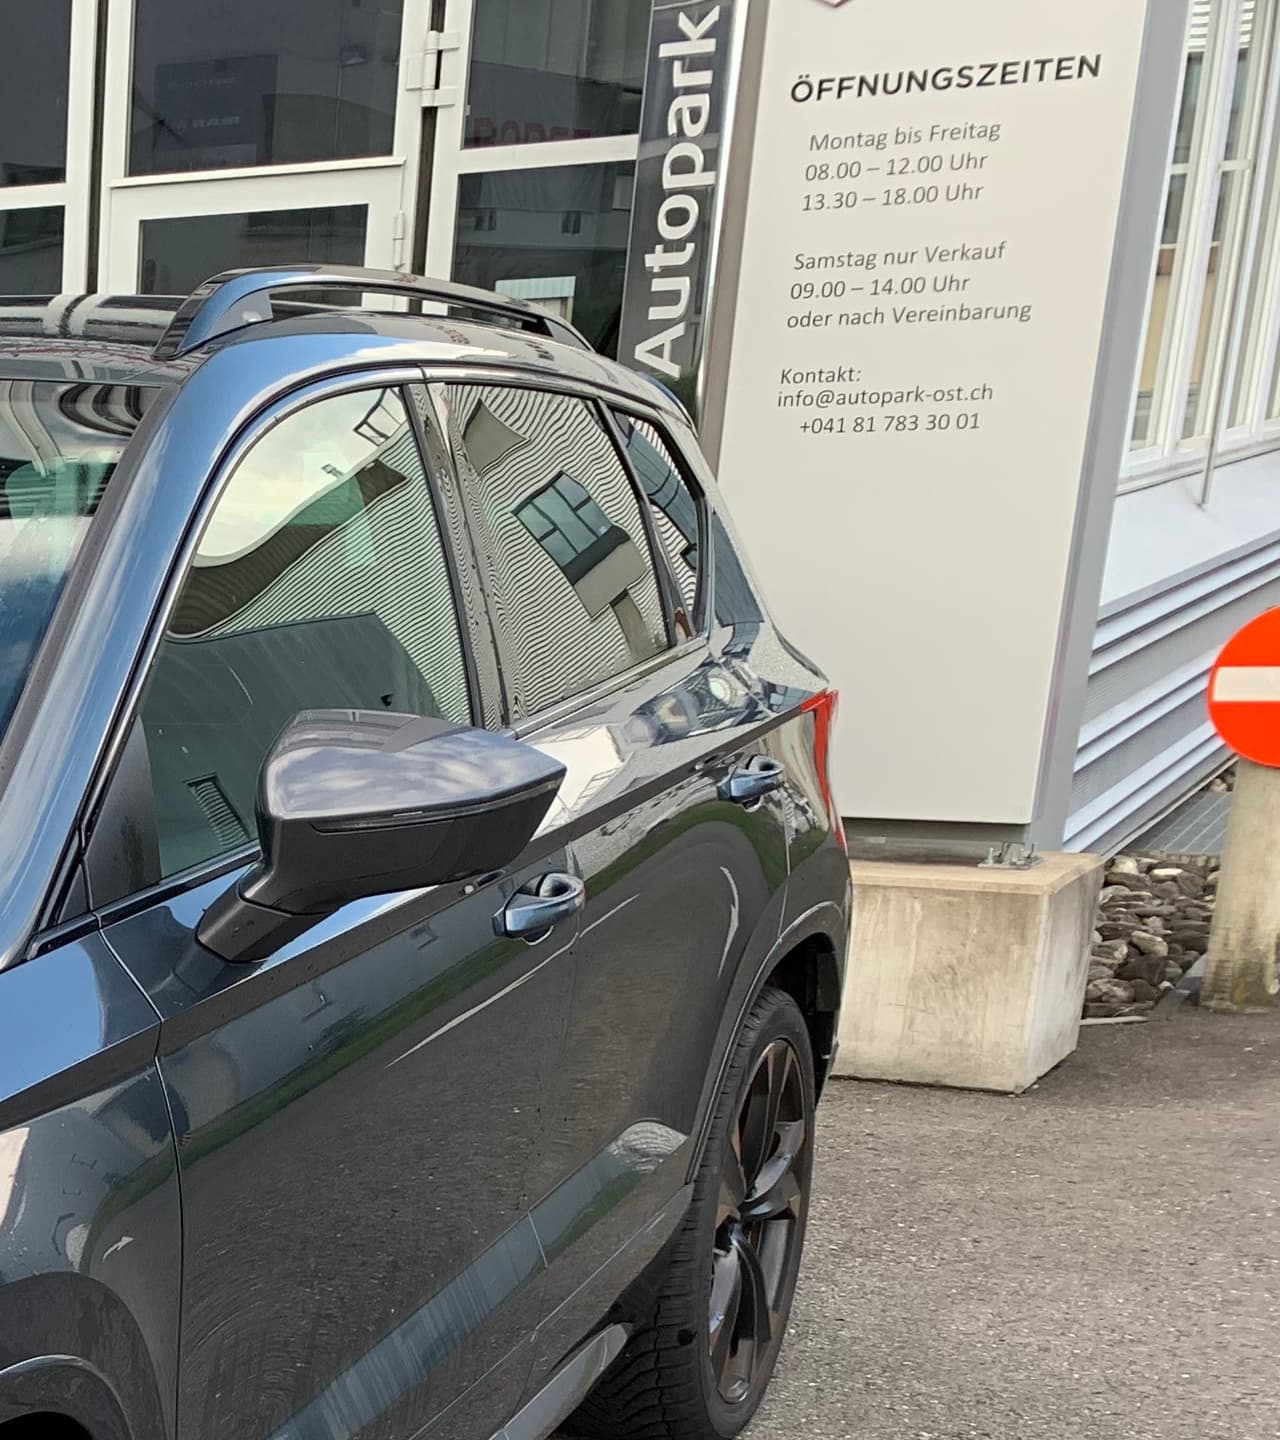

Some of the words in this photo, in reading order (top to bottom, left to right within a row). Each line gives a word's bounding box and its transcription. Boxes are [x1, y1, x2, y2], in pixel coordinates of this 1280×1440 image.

[790, 53, 1102, 103] ÖFFNUNGSZEITEN
[809, 132, 888, 151] Montag
[894, 126, 923, 145] bis
[929, 121, 1001, 143] Freitag
[804, 160, 862, 182] 08.00
[885, 154, 944, 177] 12.00
[949, 151, 989, 172] Uhr
[634, 4, 720, 378] Autopark
[801, 191, 858, 212] 13.30
[881, 184, 940, 207] 18.00
[945, 182, 985, 203] Uhr
[793, 251, 878, 271] Samstag
[882, 249, 920, 266] nur
[924, 240, 1008, 264] Verkauf
[790, 280, 846, 301] 09.00
[869, 275, 927, 296] 14.00
[932, 273, 971, 294] Uhr
[786, 309, 834, 329] oder
[838, 306, 885, 326] nach
[891, 302, 1033, 324] Vereinbarung
[780, 365, 862, 385] Kontakt:
[777, 383, 993, 410] info@autopark-ost.ch
[799, 415, 847, 435] +041
[852, 415, 877, 433] 81
[882, 414, 920, 433] 783
[924, 413, 951, 431] 30
[955, 411, 980, 430] 01
